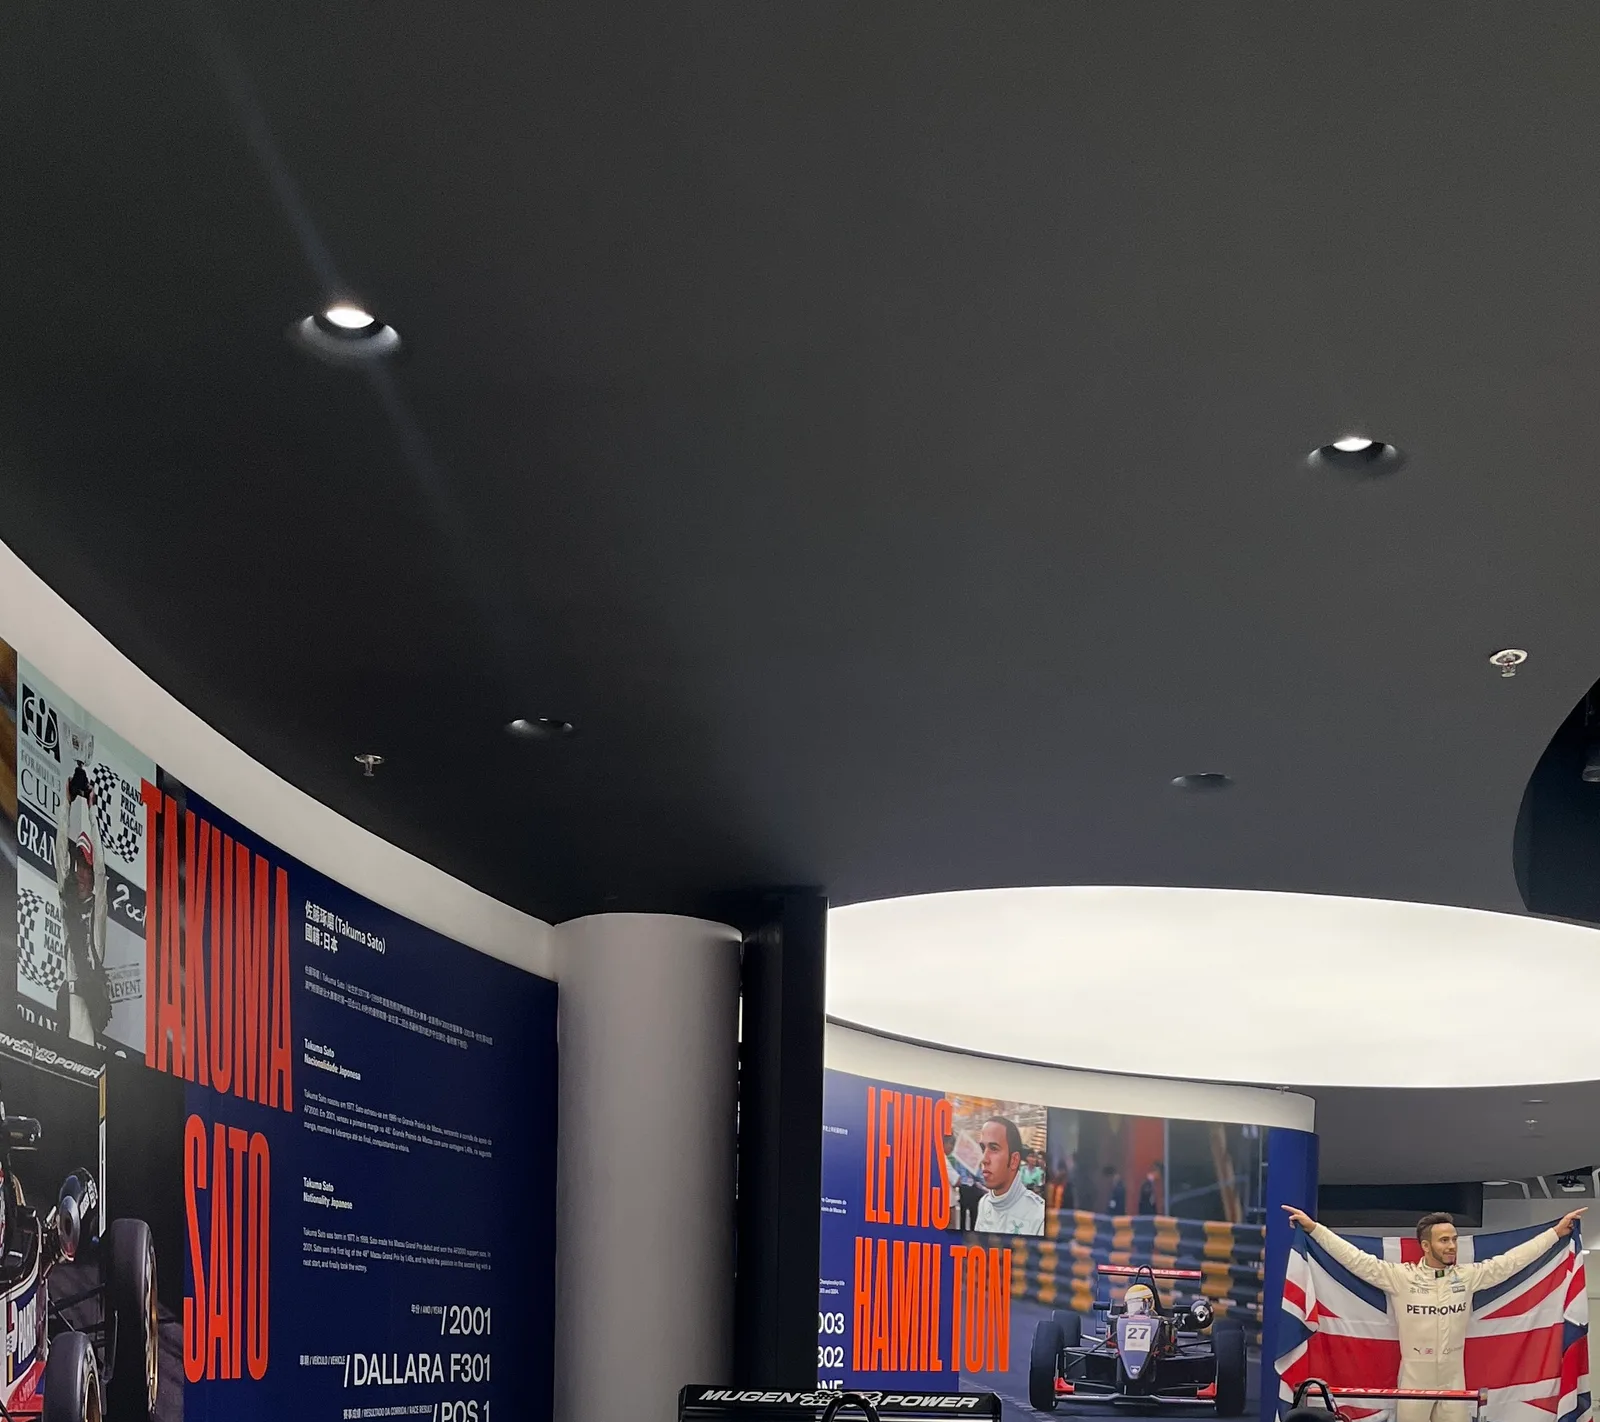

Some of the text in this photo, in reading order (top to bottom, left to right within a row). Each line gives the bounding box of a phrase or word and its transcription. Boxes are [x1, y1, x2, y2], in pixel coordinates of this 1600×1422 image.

[21, 768, 61, 815] CUP
[120, 811, 143, 837] MACAU
[141, 777, 293, 1112] TAKUMA
[864, 1086, 952, 1231] LEWIS
[183, 1114, 271, 1383] SATO
[1407, 1302, 1467, 1316] PETRONAS
[1127, 1327, 1149, 1340] 27
[450, 1353, 491, 1383] F301
[699, 1389, 980, 1408] MUGEN POWER
